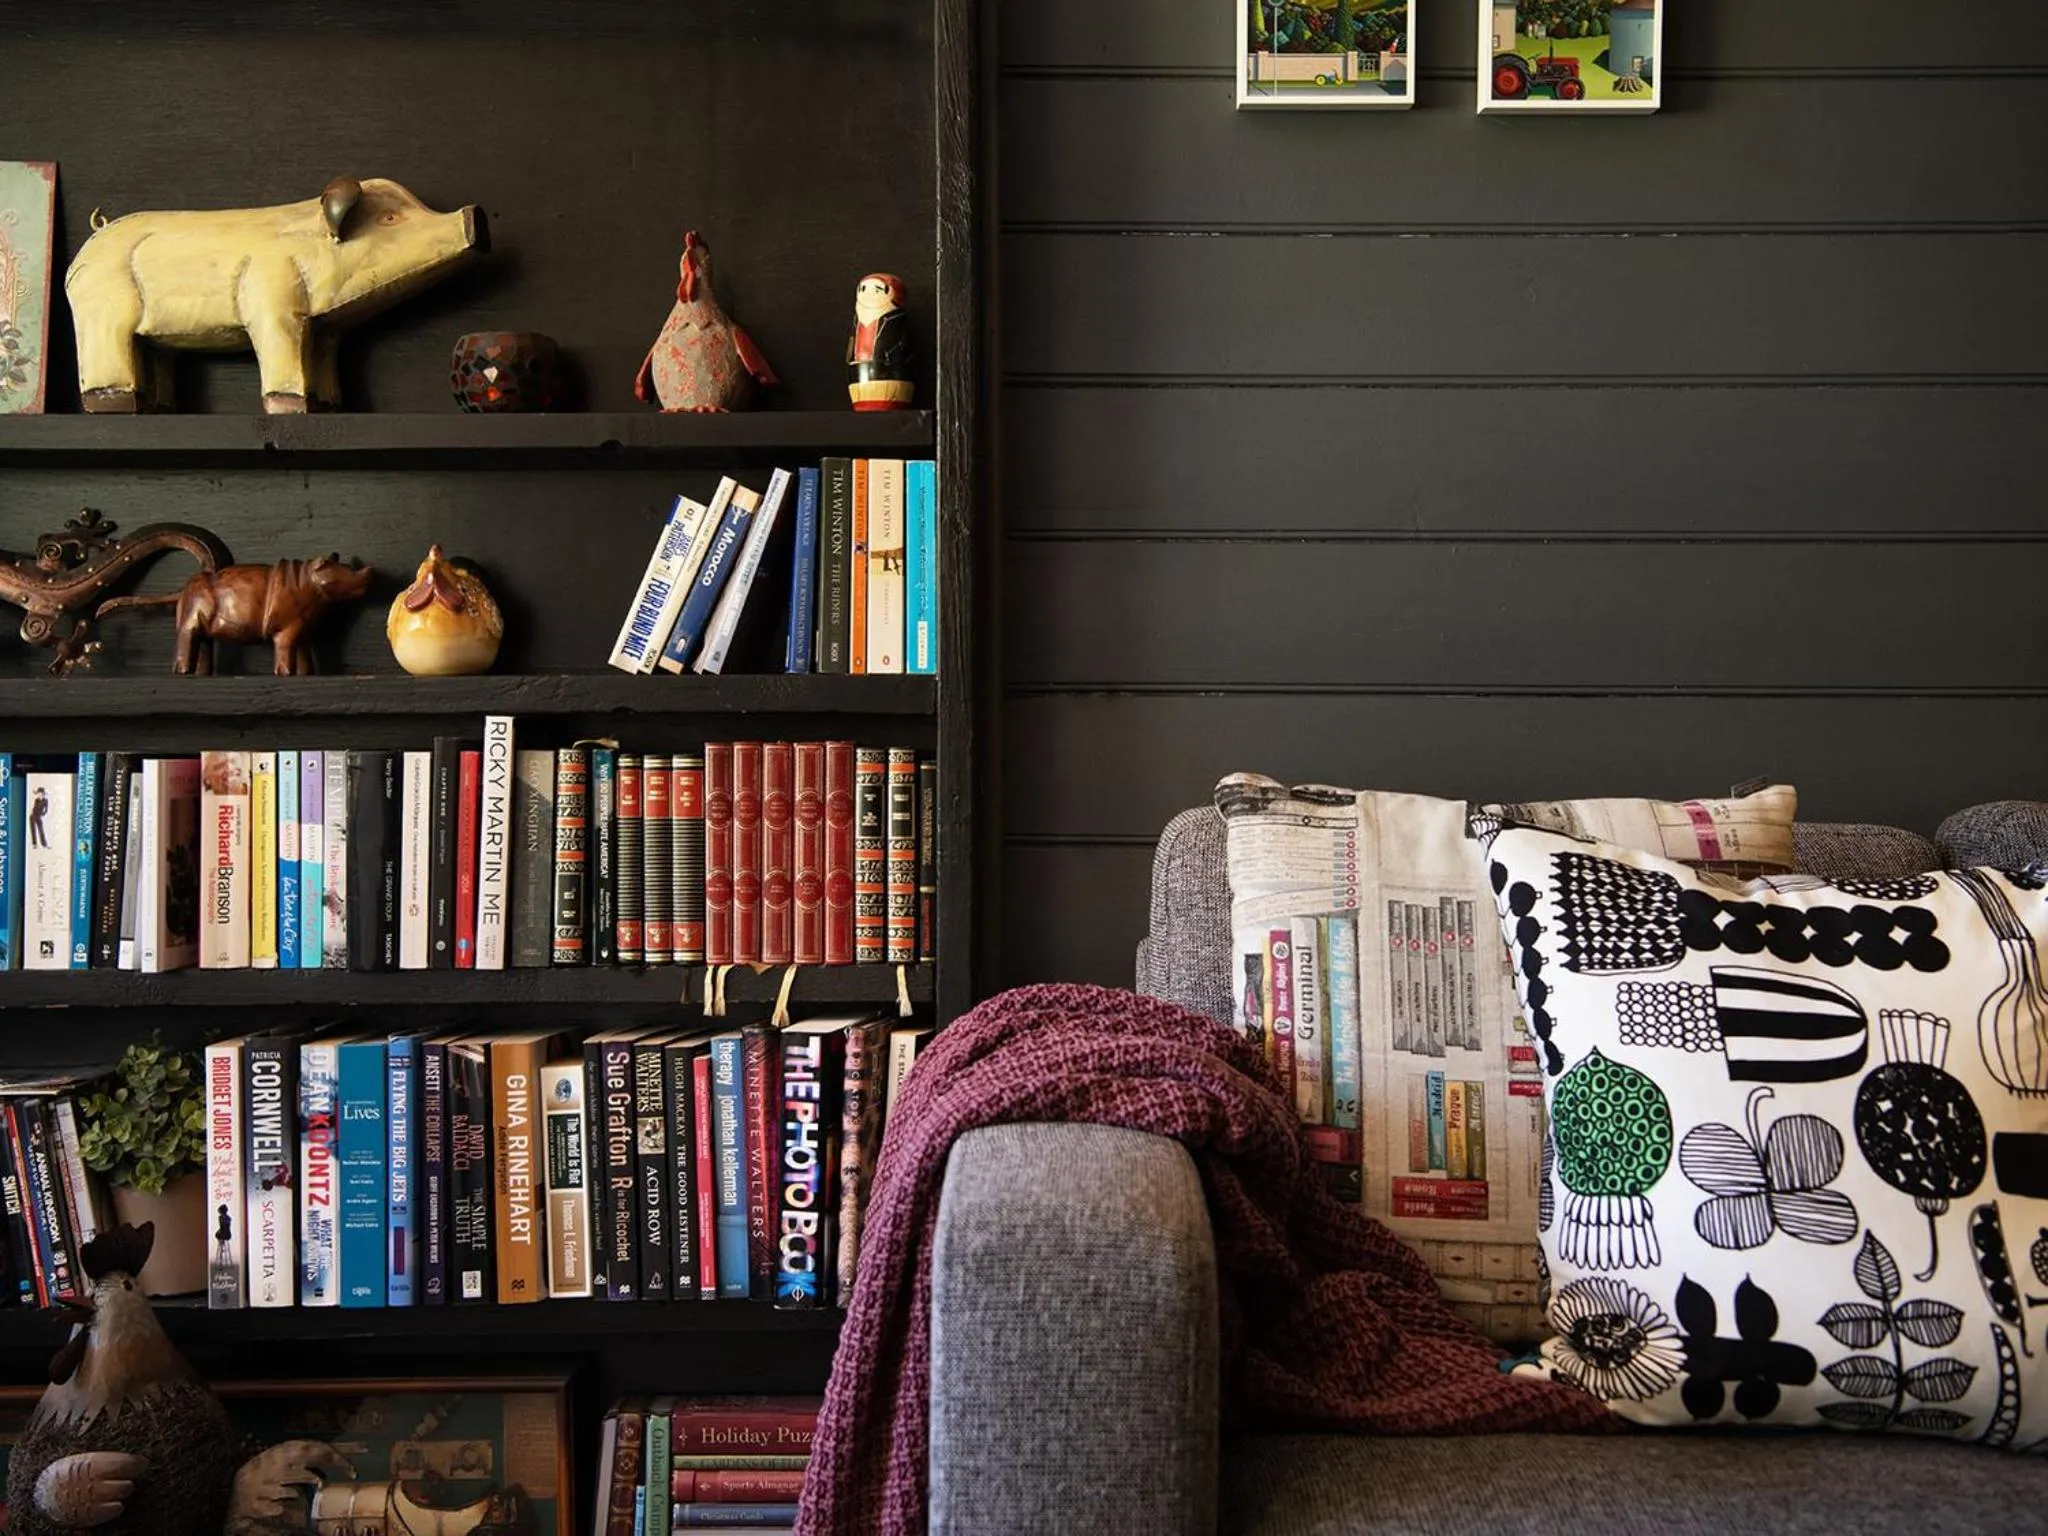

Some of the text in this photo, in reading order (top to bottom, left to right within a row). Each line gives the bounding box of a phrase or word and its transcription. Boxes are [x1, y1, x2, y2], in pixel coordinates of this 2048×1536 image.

[856, 495, 864, 540] WINTON
[660, 520, 685, 562] PATTERSON
[701, 526, 736, 589] Morocco
[832, 469, 843, 624] TIM WINTON THE RIDERS
[621, 577, 671, 662] FOUR BLIND MICE
[385, 759, 393, 775] Harry
[489, 721, 507, 789] RICKY
[84, 761, 95, 834] HILLARY CLINTON
[107, 796, 115, 811] the
[114, 769, 123, 815] Inspector
[105, 816, 113, 836] Ship
[112, 819, 121, 850] Anders
[485, 797, 502, 882] MARTIN
[527, 792, 539, 852] XINGJIAN
[600, 764, 608, 878] WHY DO PEOPLE HATE AMERICA?
[104, 855, 112, 882] Fools
[330, 844, 338, 860] The
[207, 880, 215, 924] Autobiography
[461, 875, 469, 894] 2014
[483, 894, 500, 925] ME
[1295, 945, 1314, 1040] Germinal
[251, 1051, 281, 1060] PATRICIA
[213, 1057, 232, 1149] BRIDGET JONES
[392, 1070, 406, 1114] FLYING
[636, 1053, 649, 1112] WALTERS
[649, 1052, 662, 1111] MINETTE
[1431, 1076, 1442, 1120] Madrid
[252, 1060, 282, 1173] CORNWELL
[307, 1051, 330, 1207] DEAN KOONTZ
[344, 1105, 380, 1120] Lives
[393, 1117, 406, 1143] THE
[425, 1055, 440, 1162] ANSETT THE COLLAPSE
[567, 1118, 579, 1132] The
[607, 1052, 631, 1166] Sue Grafton
[717, 1042, 740, 1206] therapy jonathan kellerman
[1449, 1089, 1460, 1129] Prague
[393, 1147, 407, 1168] BIG
[452, 1115, 468, 1171] BALDACCI
[468, 1125, 484, 1160] DAVID
[498, 1126, 508, 1195] Adele Ferguson
[507, 1074, 531, 1245] GINA RINEHART
[568, 1134, 580, 1157] World
[675, 1057, 689, 1264] HUGH MACKAY THE GOOD LISTENER
[748, 1050, 764, 1238] MINETTE WALTERS
[35, 1152, 50, 1192] ANIMAL
[43, 1190, 61, 1243] KINGDOM
[393, 1172, 406, 1202] JETS
[569, 1169, 581, 1184] Flat
[611, 1177, 632, 1188] R
[307, 1210, 320, 1241] NIGHT
[455, 1197, 469, 1243] TRUTH
[617, 1198, 626, 1210] for
[646, 1166, 661, 1246] ACID ROW
[1404, 1202, 1434, 1214] Paris
[262, 1200, 276, 1279] SCARPETTA
[320, 1218, 332, 1248] WHAT
[430, 1228, 438, 1243] PETER
[471, 1205, 486, 1250] SIMPLE
[562, 1200, 576, 1278] Thomas Friedman
[615, 1212, 630, 1262] Ricochet
[652, 1429, 665, 1488] Outback
[701, 1427, 814, 1446] Holiday Puz
[723, 1481, 754, 1491] Sports
